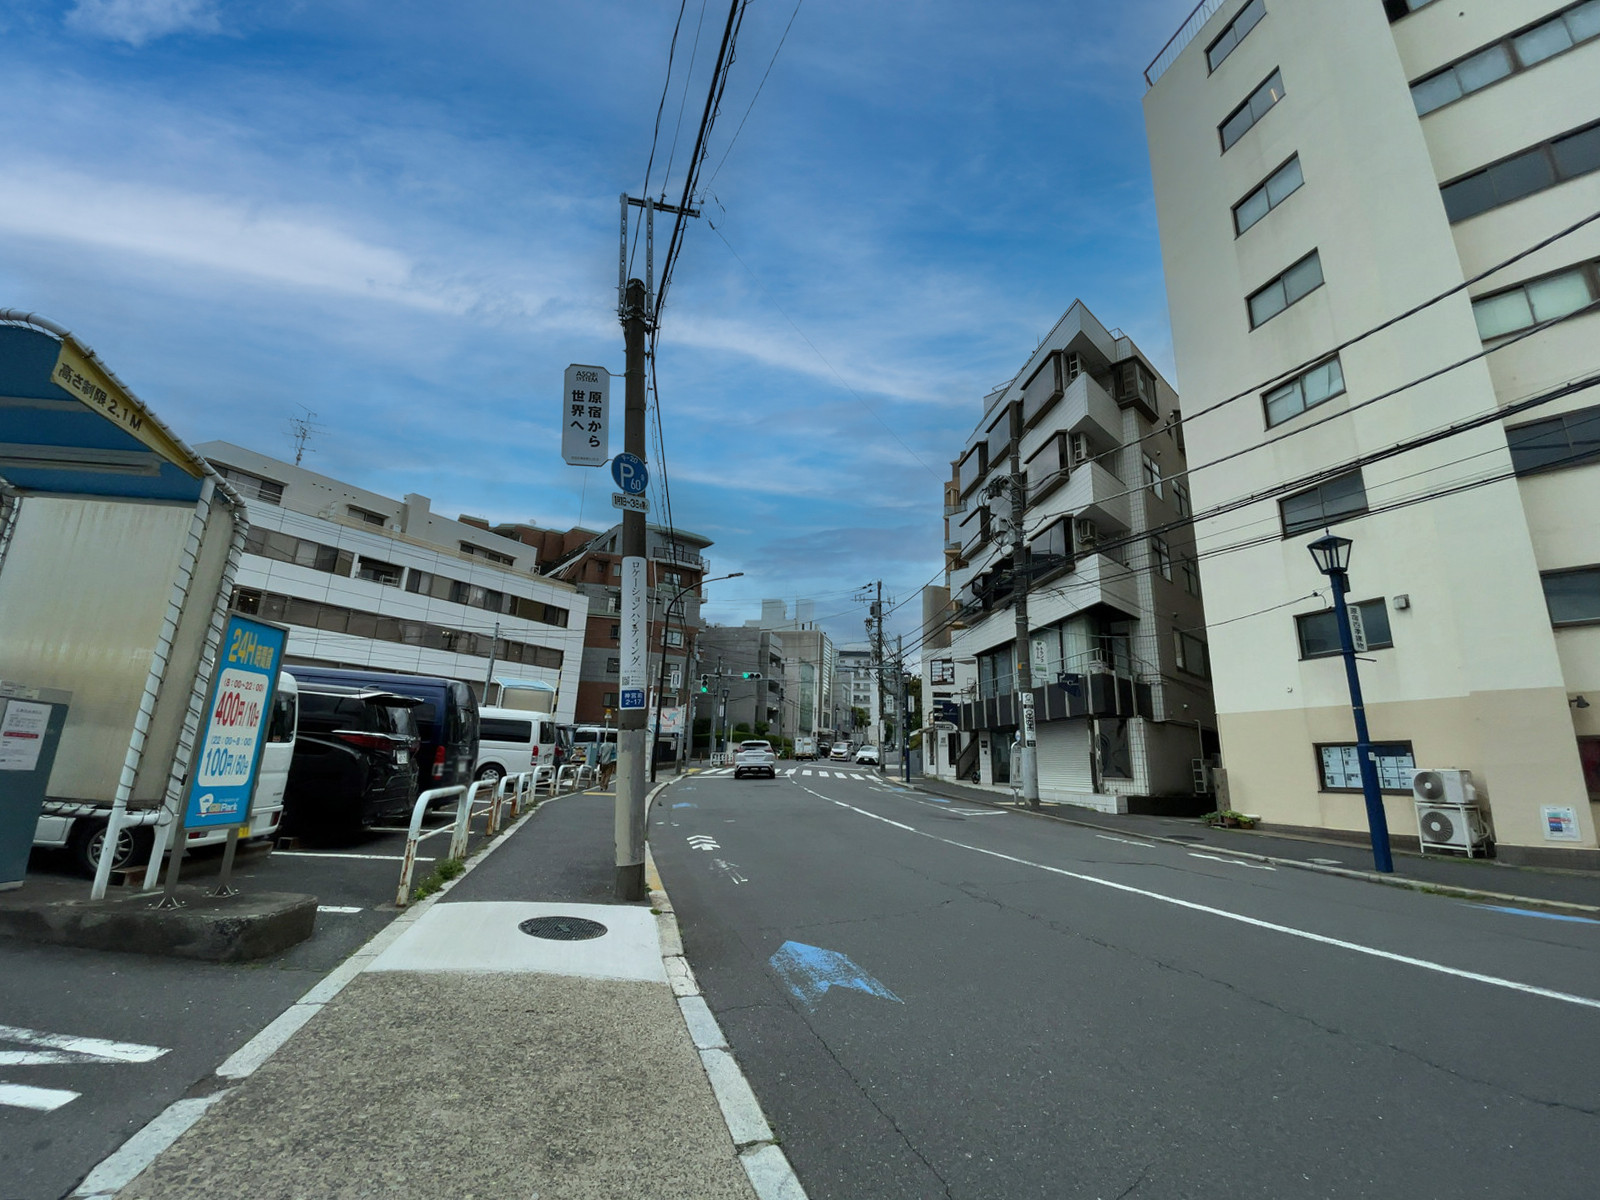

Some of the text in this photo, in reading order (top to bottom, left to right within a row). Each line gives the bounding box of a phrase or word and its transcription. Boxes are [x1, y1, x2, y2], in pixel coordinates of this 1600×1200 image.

[58, 362, 143, 431] 高さ制限 2.1M
[570, 389, 585, 431] 世界へ
[588, 391, 602, 448] 原宿から
[619, 462, 635, 488] P
[630, 478, 641, 491] 60
